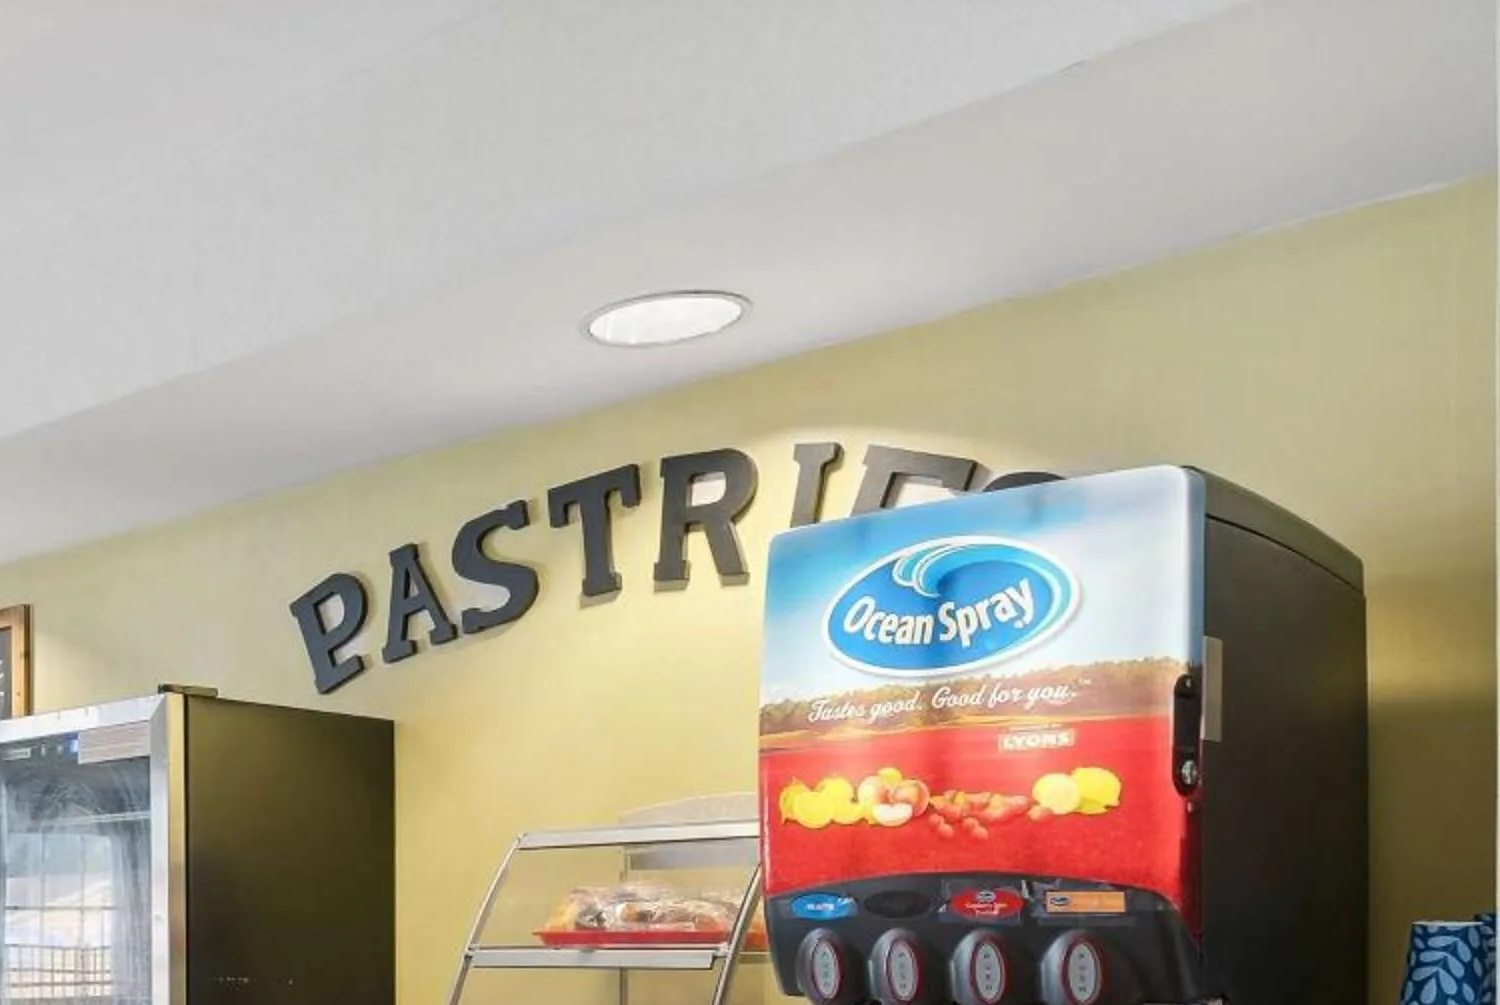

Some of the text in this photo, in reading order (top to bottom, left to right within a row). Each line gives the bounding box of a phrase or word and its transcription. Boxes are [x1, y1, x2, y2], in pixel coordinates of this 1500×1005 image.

[290, 443, 1066, 694] PASTRI
[843, 578, 1035, 649] Ocean Spray
[808, 699, 865, 722] Tastes
[867, 690, 923, 725] good.
[931, 684, 986, 709] Good
[987, 682, 1022, 709] for
[1023, 684, 1077, 711] you.
